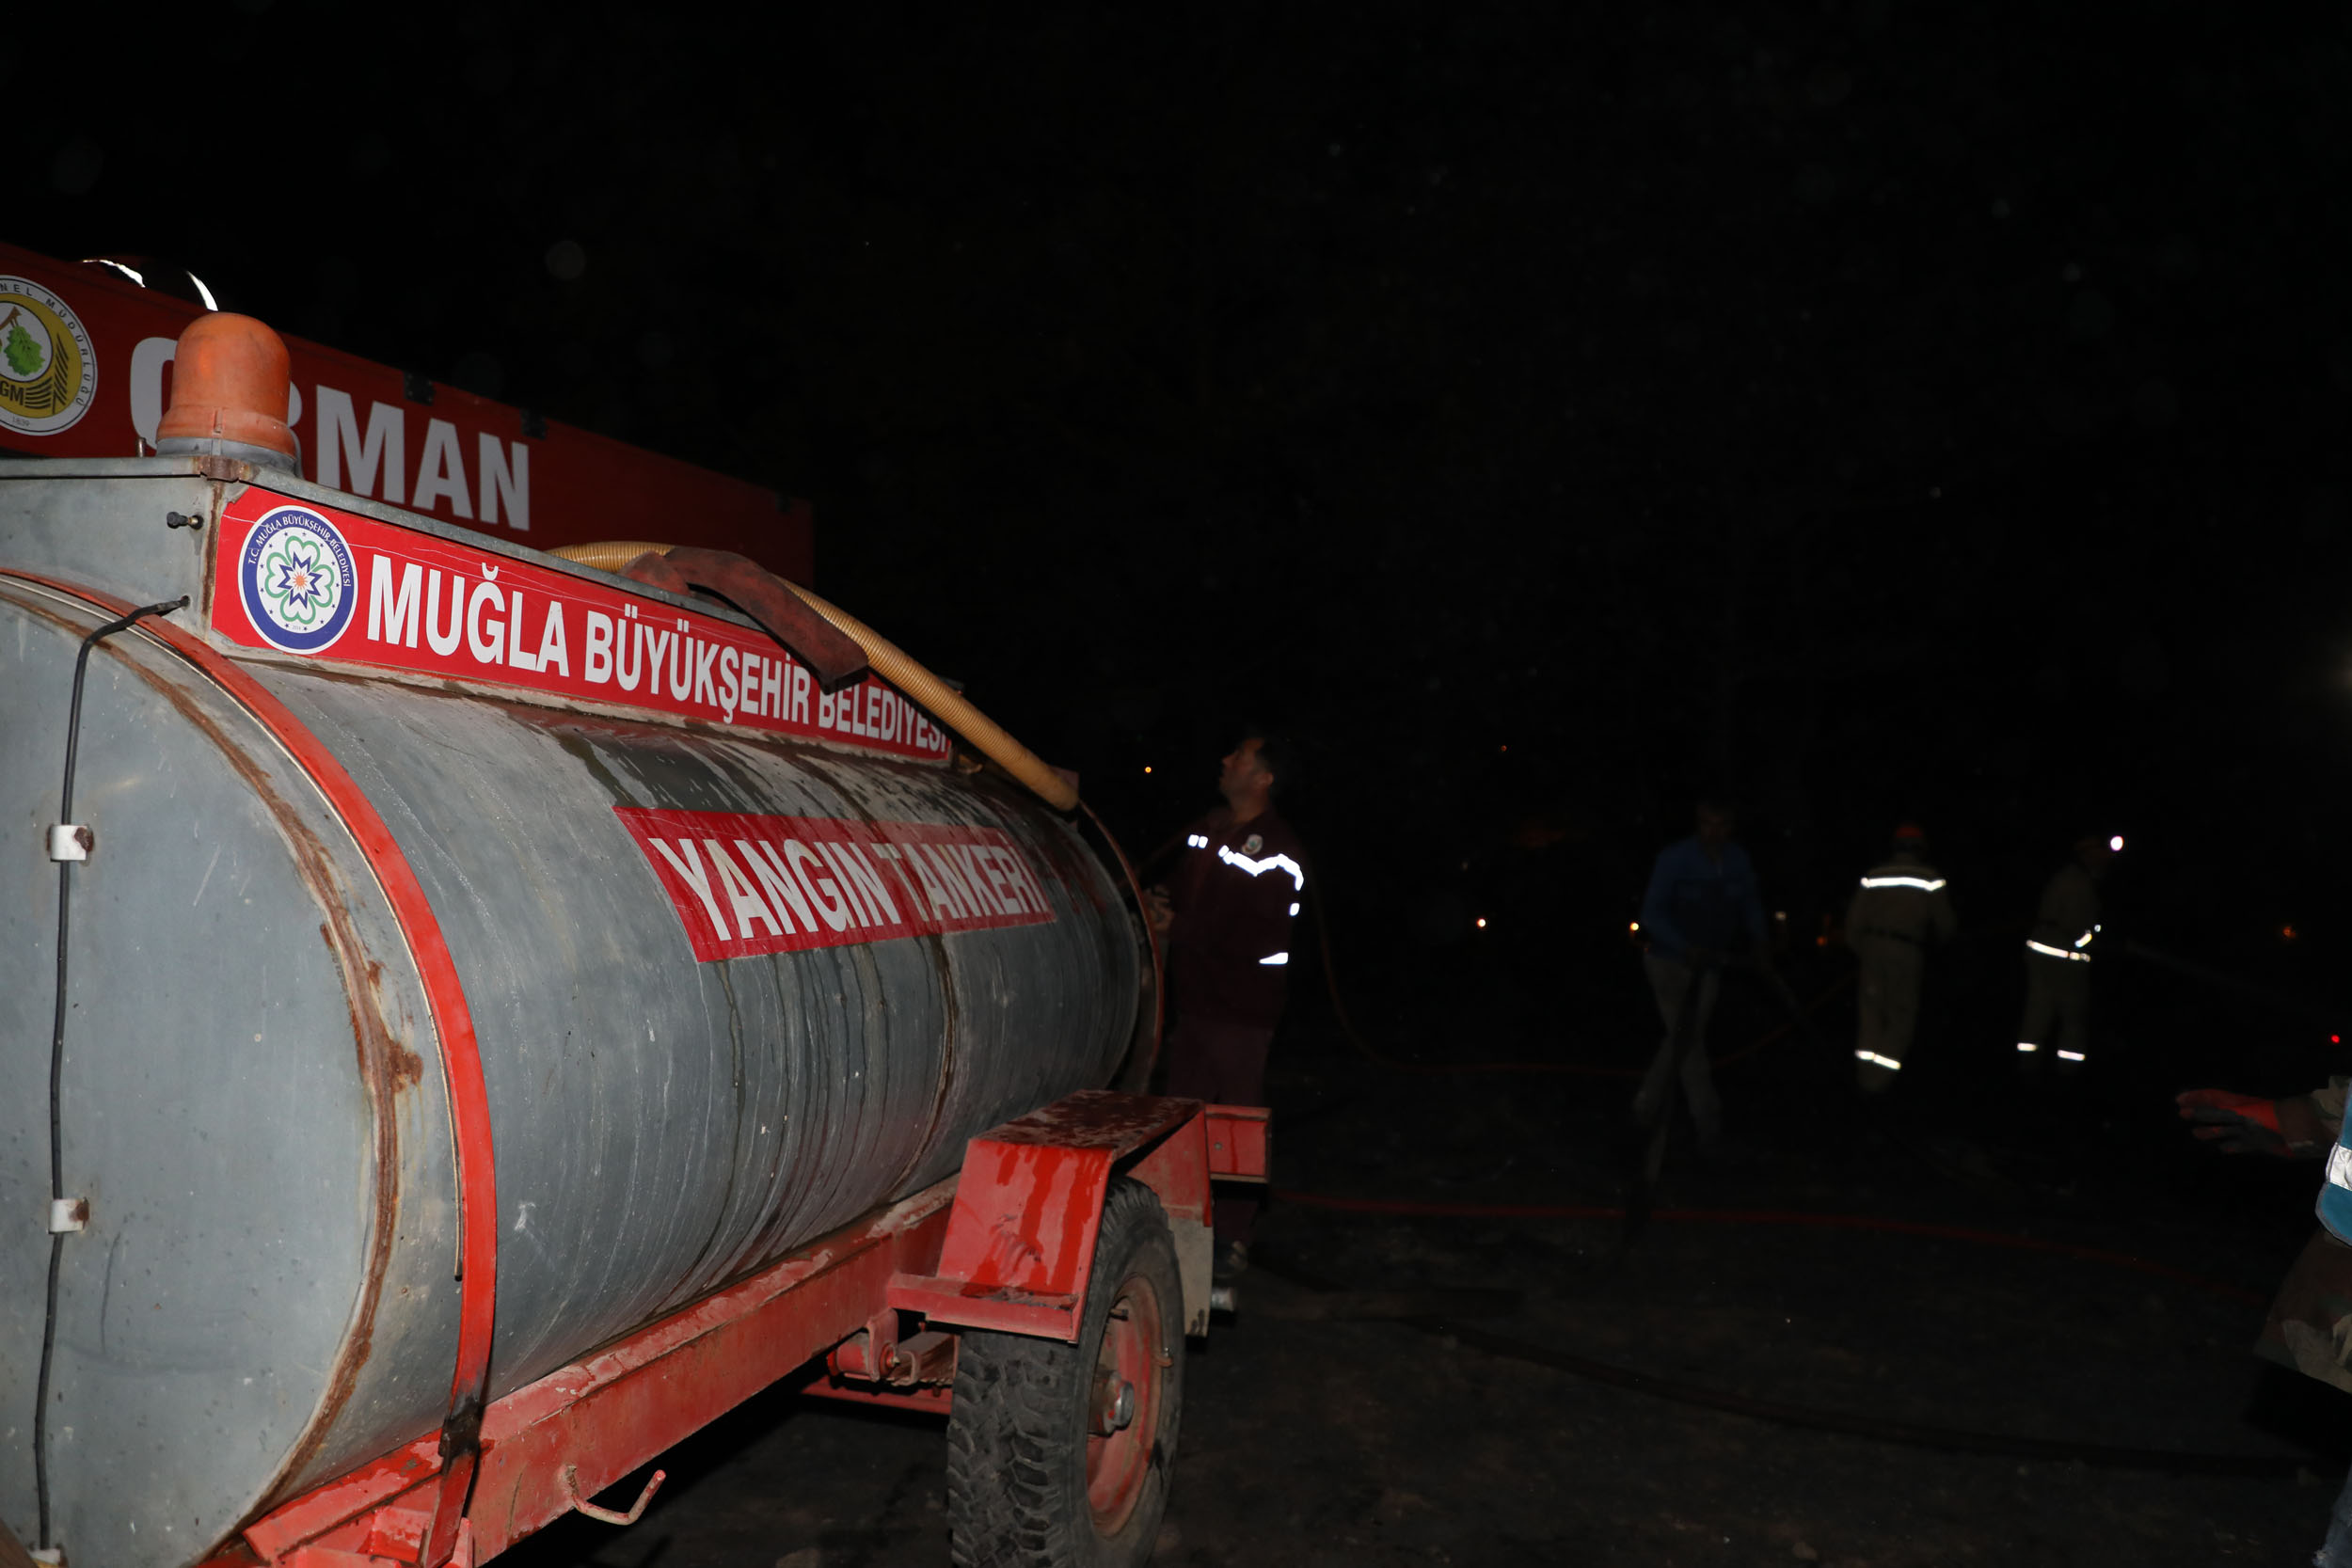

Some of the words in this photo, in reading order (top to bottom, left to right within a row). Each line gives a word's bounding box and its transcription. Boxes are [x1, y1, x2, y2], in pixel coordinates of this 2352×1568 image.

[129, 336, 530, 532] MAN
[255, 519, 282, 547] MUĞLA
[282, 514, 331, 542] BÜYÜKŞEHİR
[329, 539, 352, 587] BELEDİYESİ
[367, 554, 570, 677] MUĞLA
[584, 604, 810, 723] BÜYÜKŞEHİR
[647, 837, 901, 942] YANGIN
[879, 832, 1049, 923] TANKERİ
